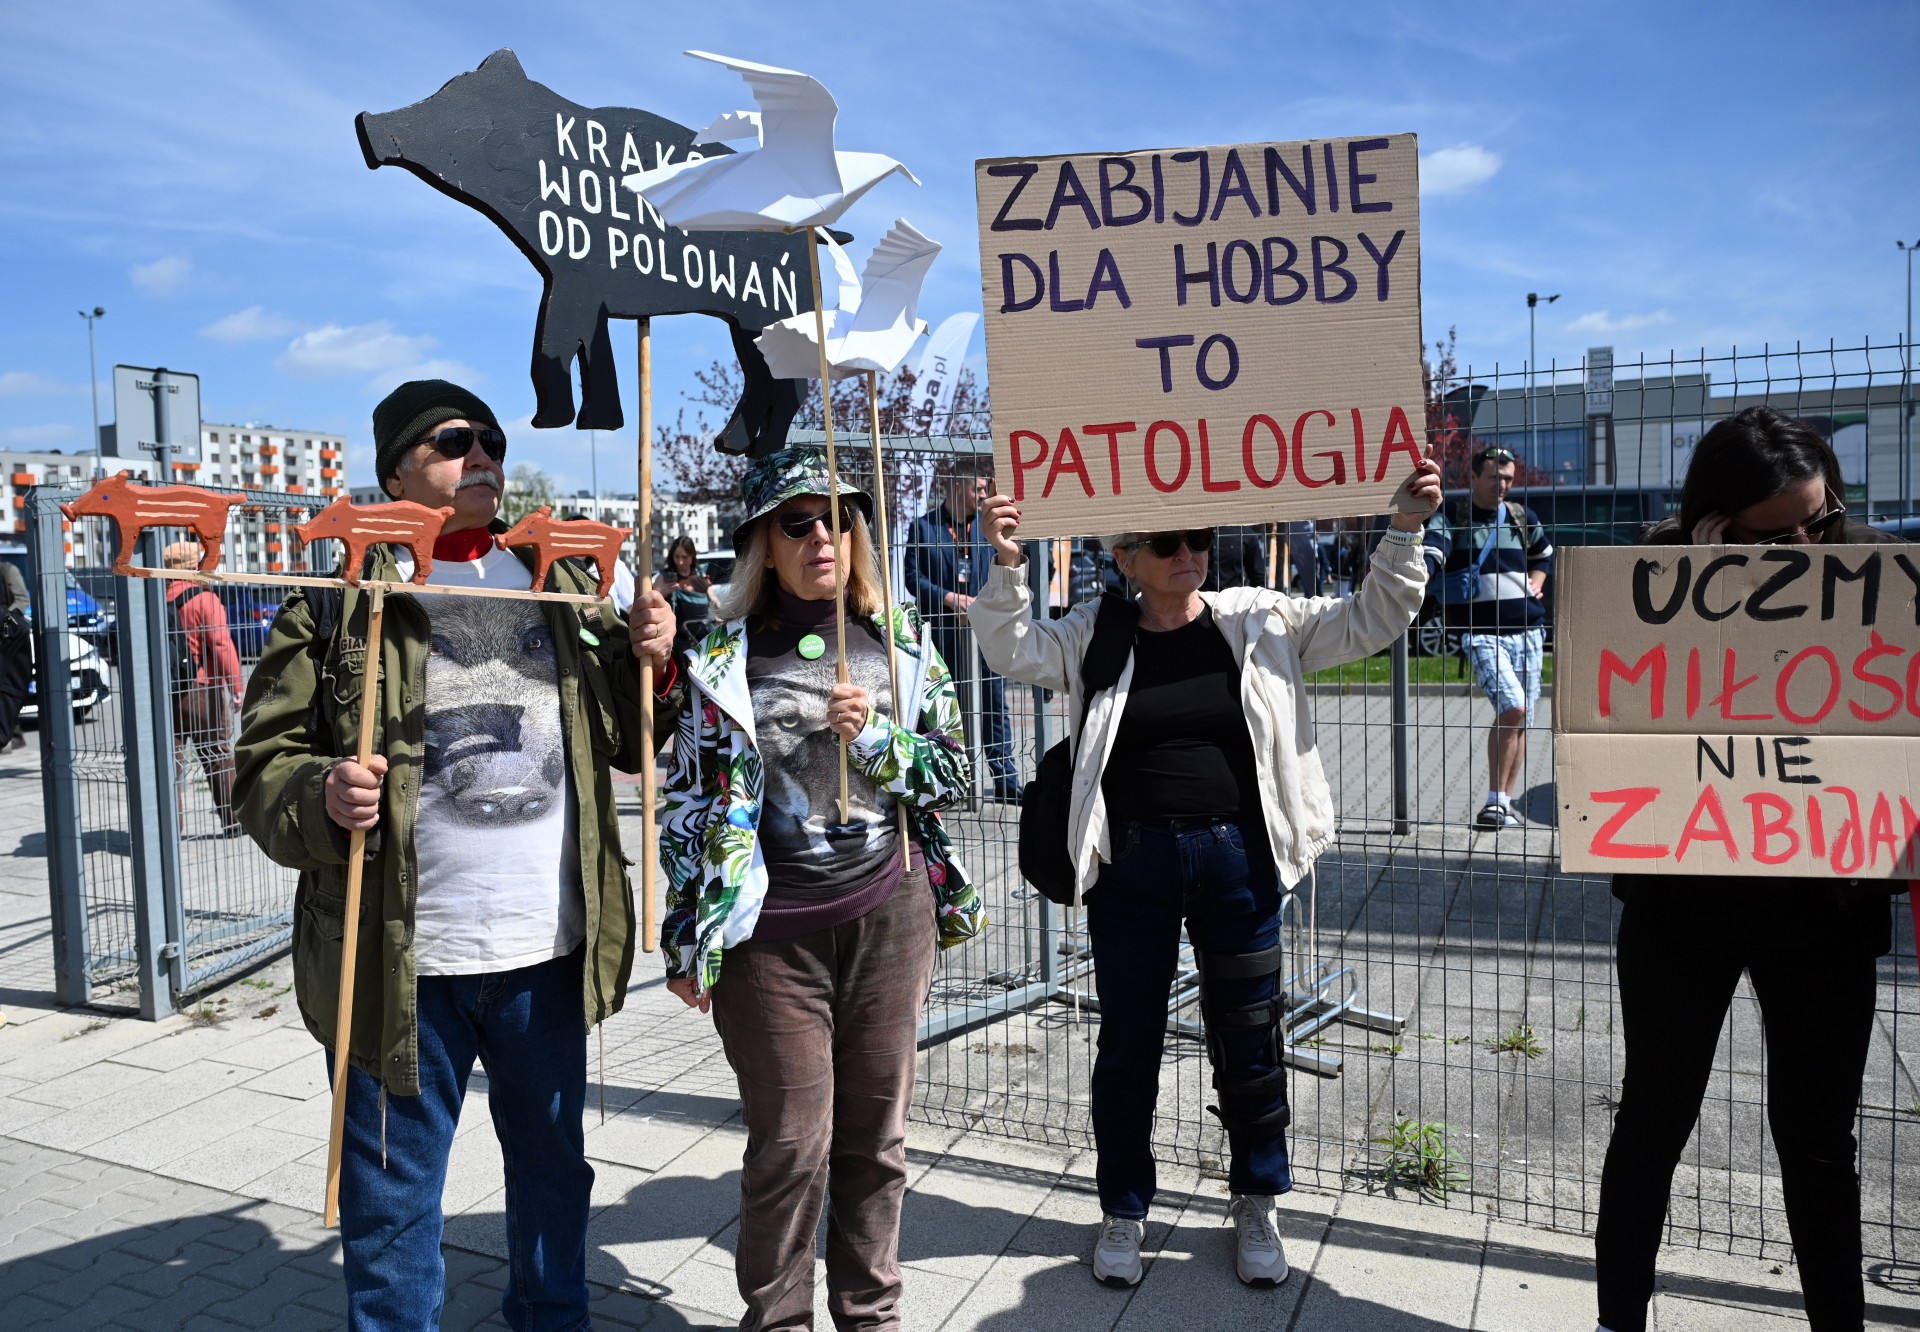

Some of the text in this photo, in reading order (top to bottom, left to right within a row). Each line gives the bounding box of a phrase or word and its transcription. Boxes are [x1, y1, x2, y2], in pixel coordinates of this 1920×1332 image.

[556, 113, 705, 173] KRAK
[539, 159, 689, 237] WOLN
[987, 138, 1393, 232] ZABIJANIE
[538, 210, 798, 316] OD POLOWAŃ
[998, 230, 1406, 314] DLA HOBBY
[1135, 333, 1240, 393] TO
[1009, 406, 1426, 501] PATOLOGIA
[1697, 736, 1822, 784] NIE
